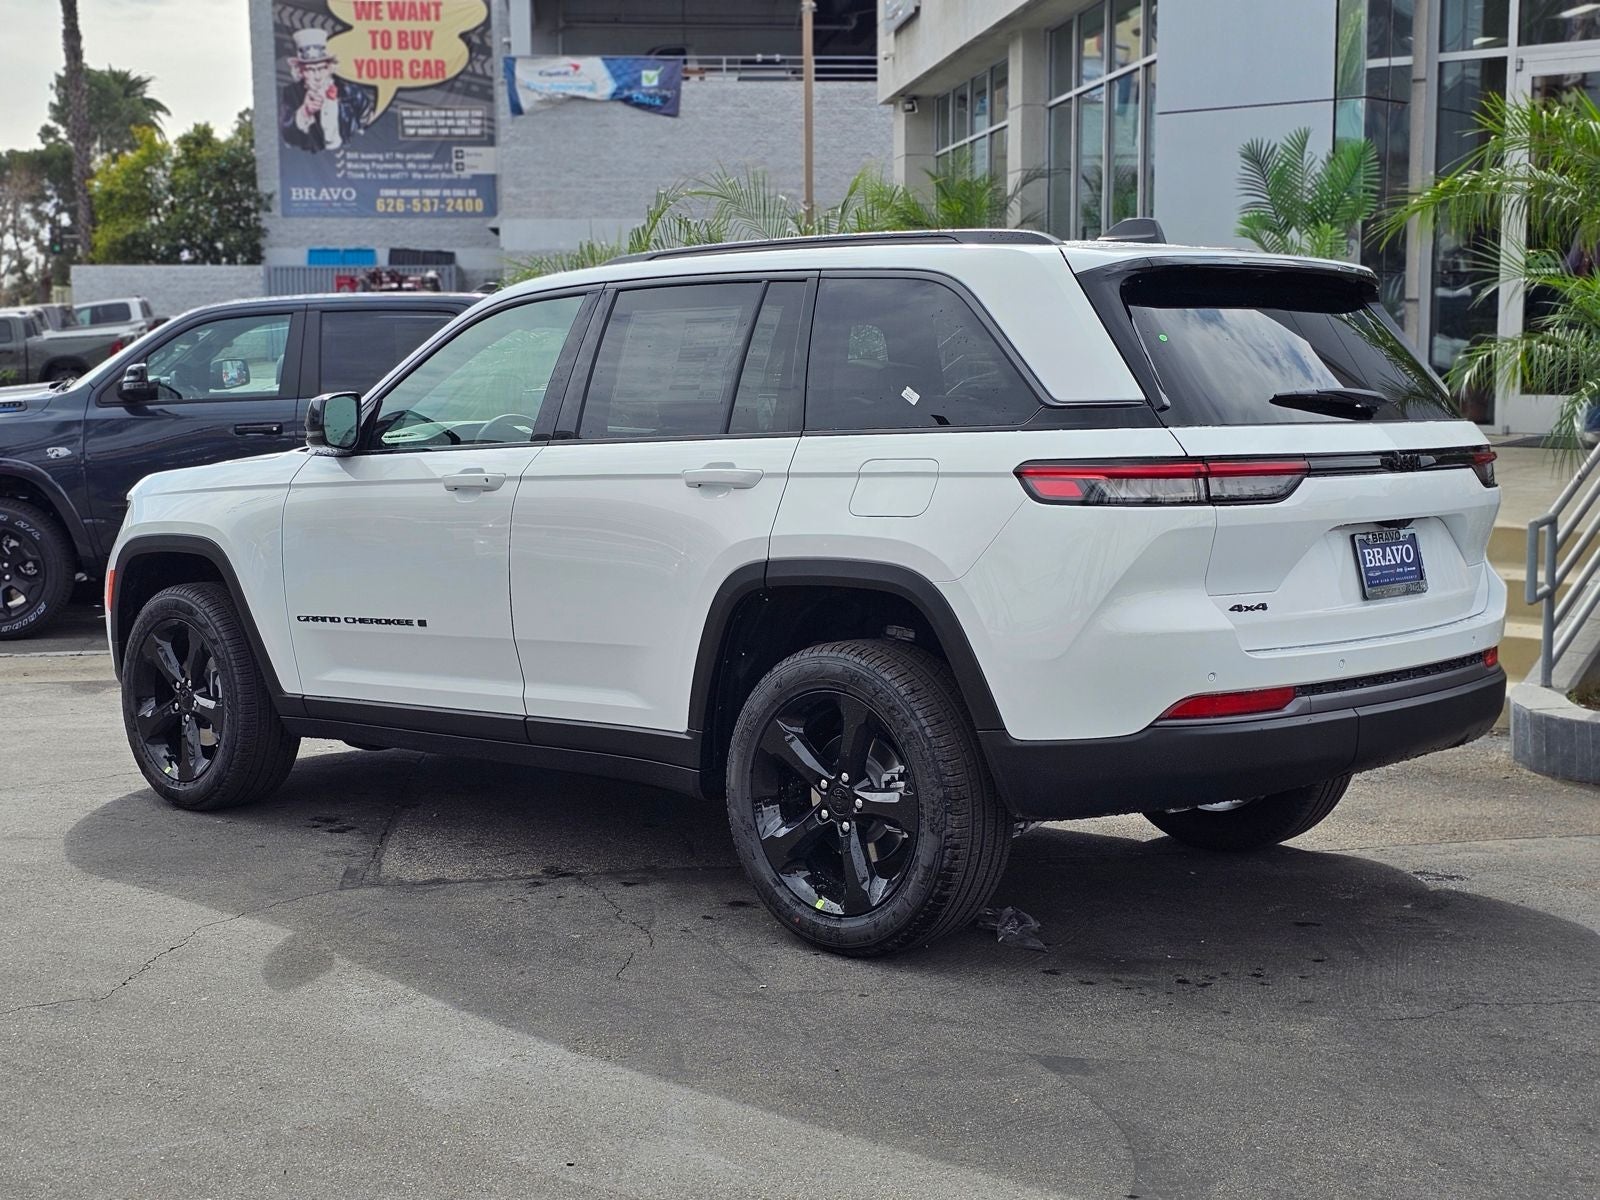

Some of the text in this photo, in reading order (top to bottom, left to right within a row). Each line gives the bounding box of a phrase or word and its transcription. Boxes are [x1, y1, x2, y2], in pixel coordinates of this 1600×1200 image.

[353, 1, 442, 21] WE WANT
[368, 29, 434, 50] TO BUY
[354, 58, 446, 79] YOUR CAR
[290, 187, 357, 201] BRAVO
[376, 198, 484, 213] 626-537-2400
[1371, 530, 1401, 543] BRAVO
[1363, 544, 1414, 568] BRAVO
[1228, 602, 1268, 613] 4x4
[296, 615, 415, 627] GRAND CHEROKEE
